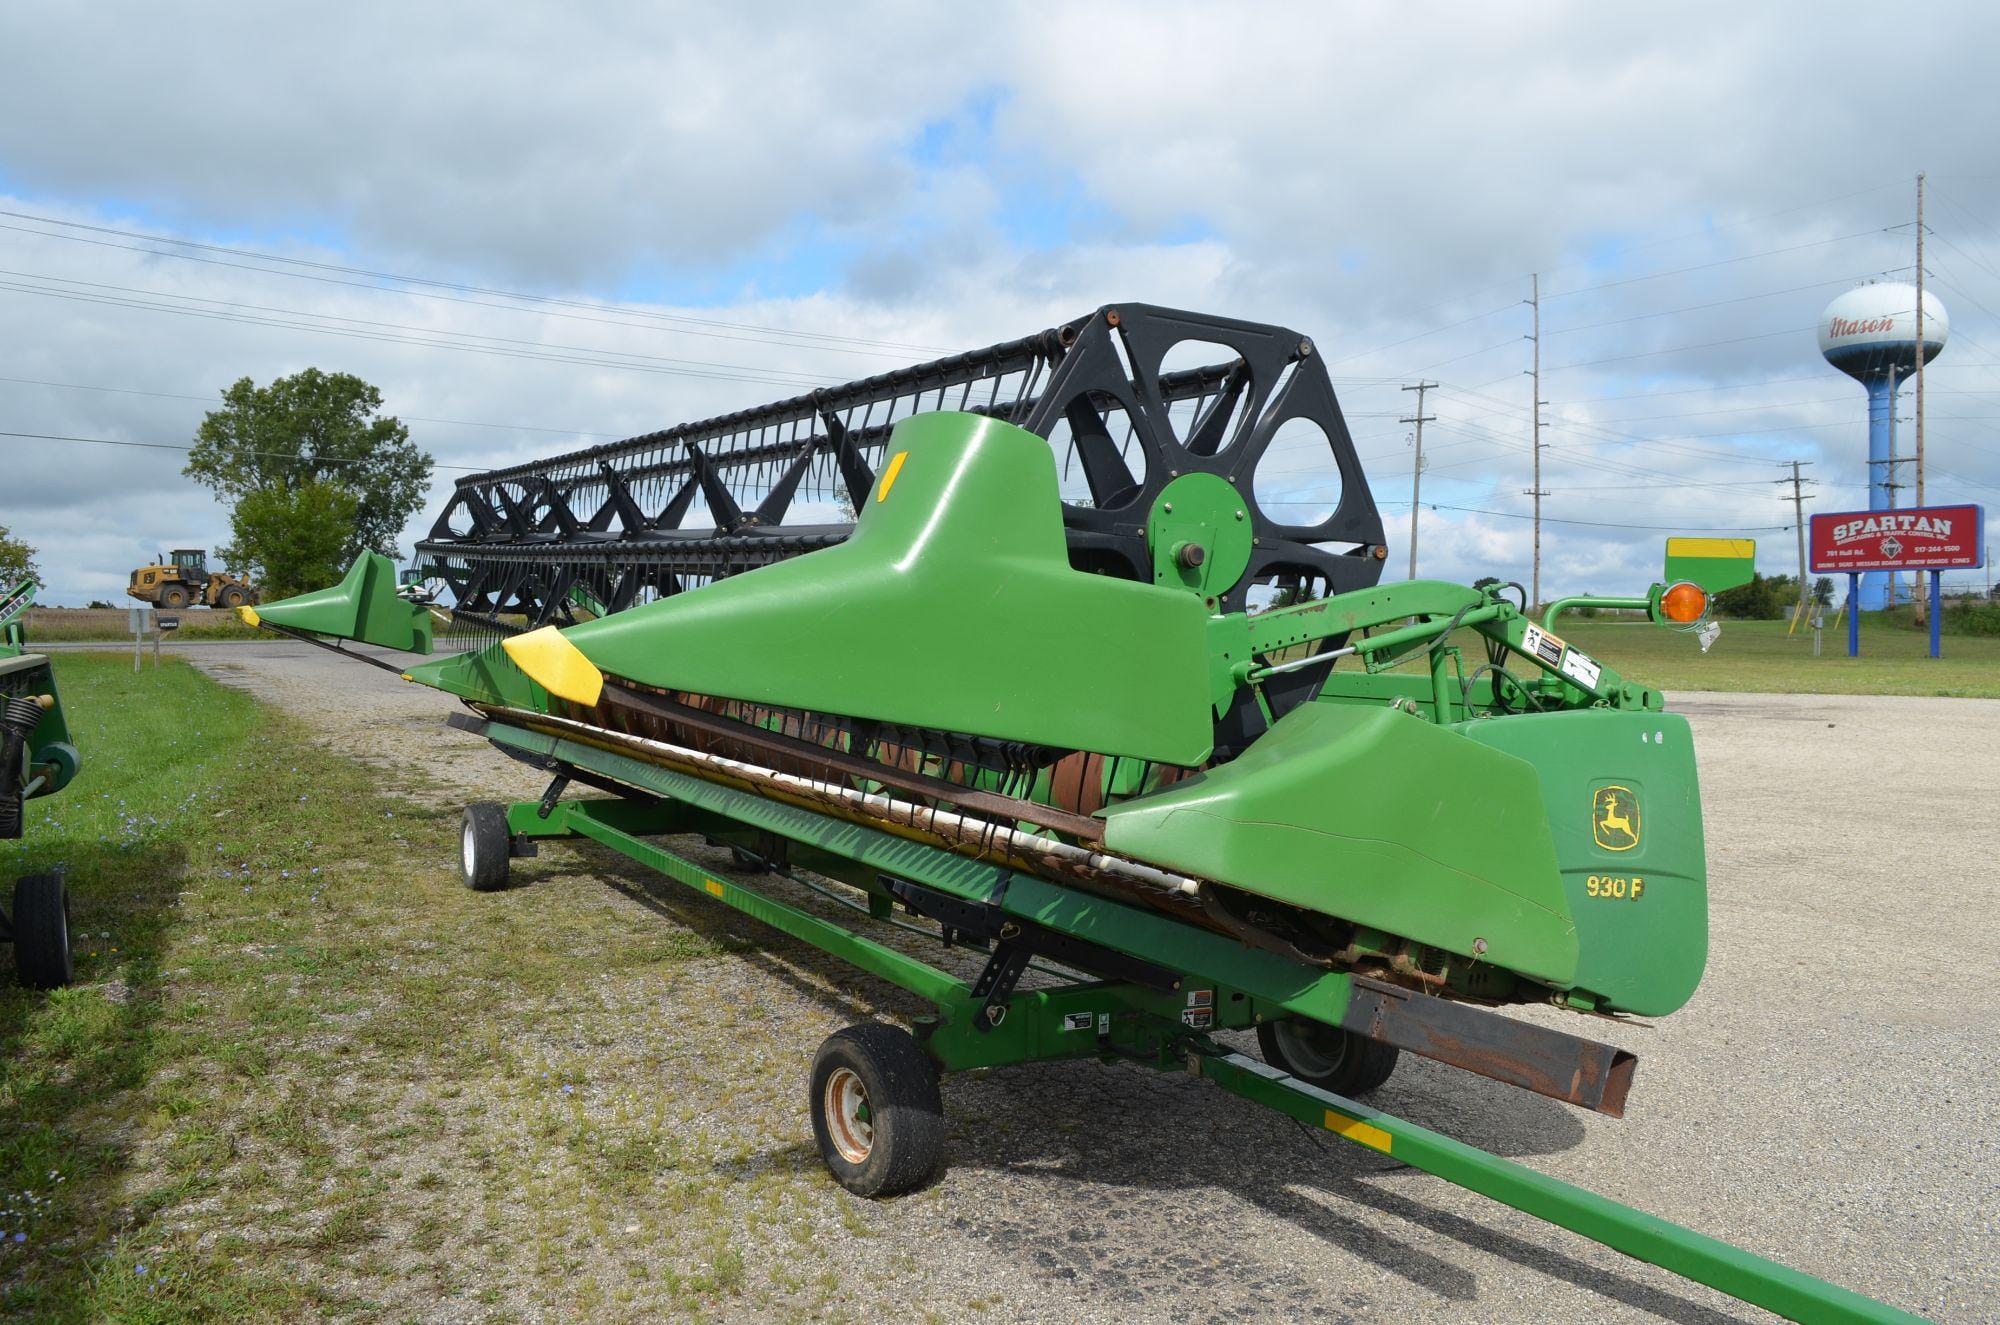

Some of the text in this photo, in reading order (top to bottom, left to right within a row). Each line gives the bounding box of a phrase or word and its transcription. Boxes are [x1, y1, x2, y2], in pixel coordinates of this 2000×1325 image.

[1830, 317, 1894, 339] Mason
[1832, 515, 1953, 541] SPARTAN
[1586, 875, 1645, 900] 930 F
